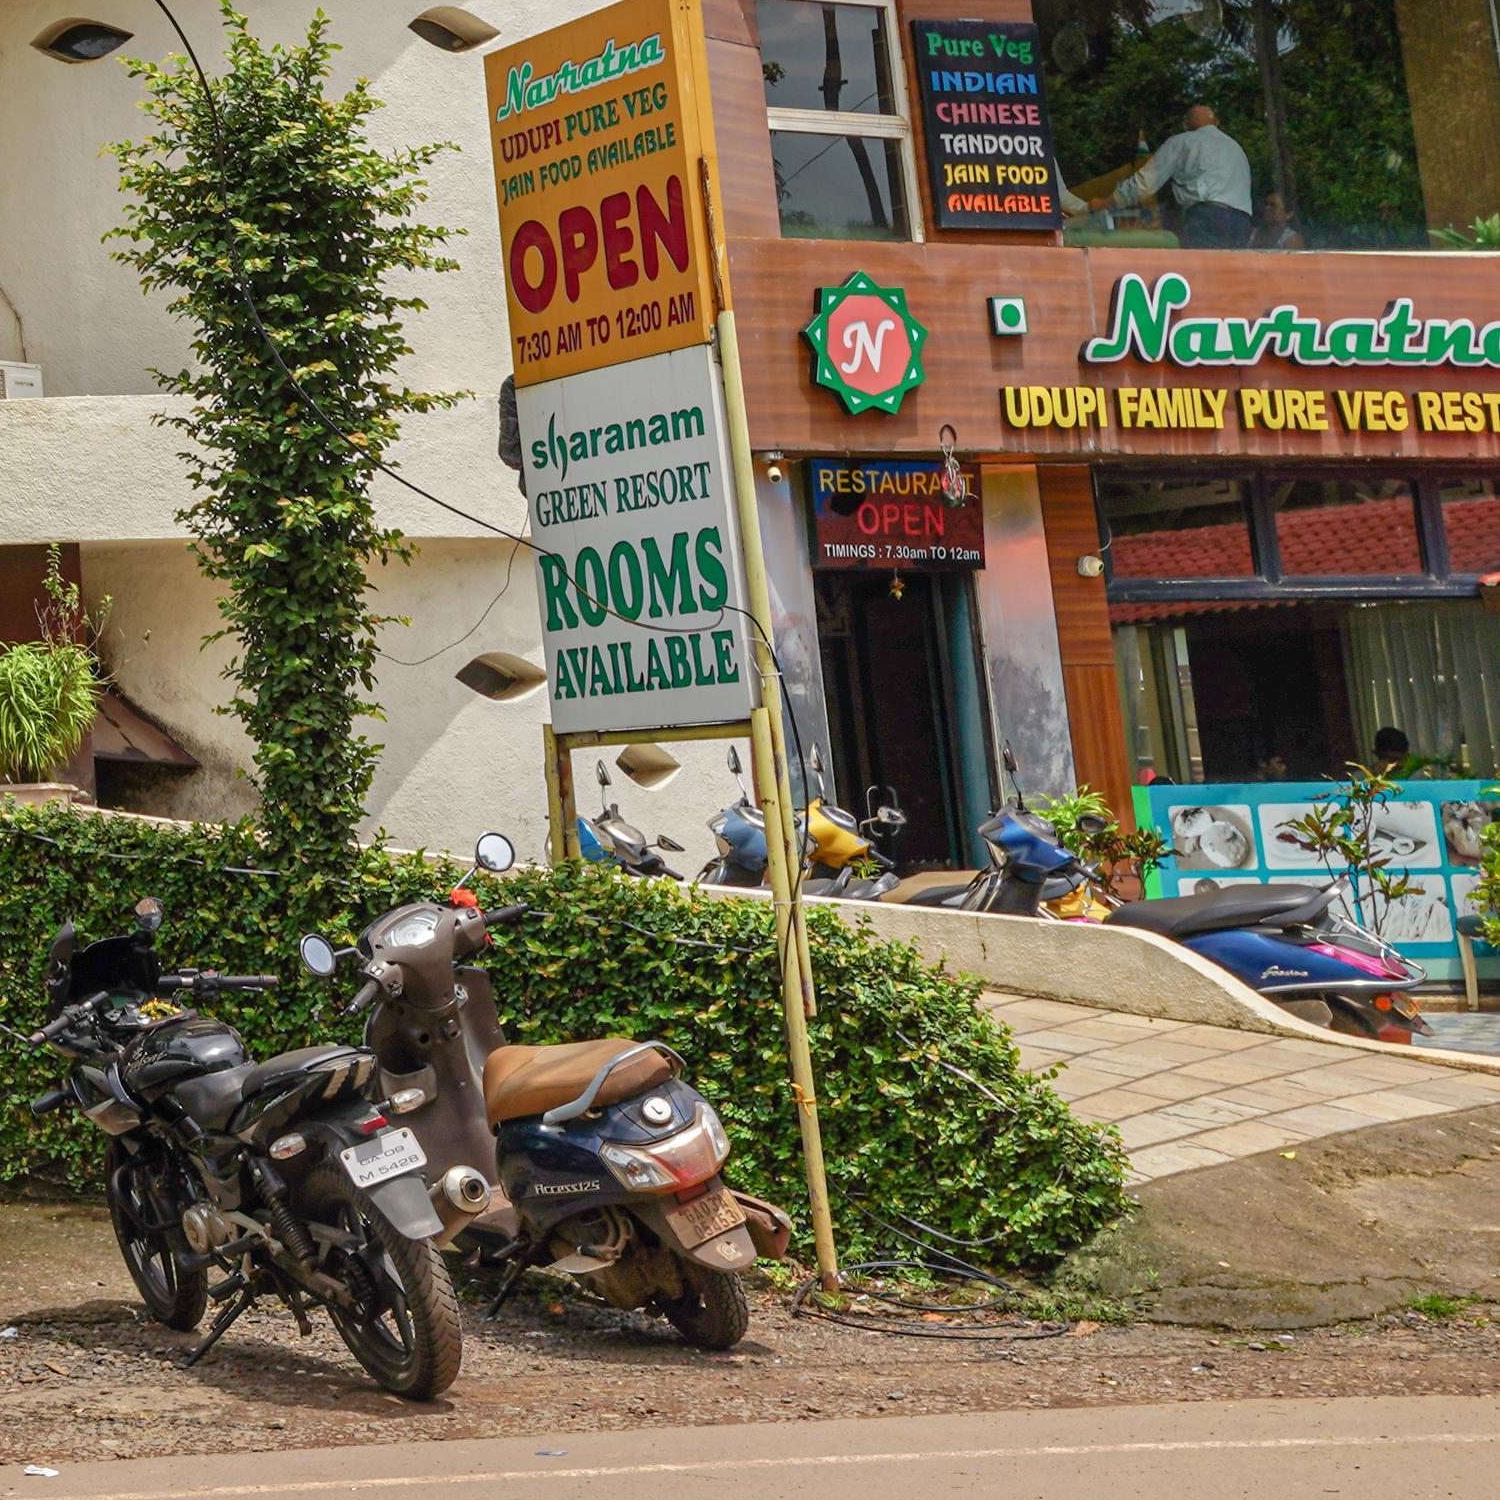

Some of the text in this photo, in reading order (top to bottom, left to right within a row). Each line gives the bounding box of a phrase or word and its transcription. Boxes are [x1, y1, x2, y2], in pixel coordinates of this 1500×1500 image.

[926, 32, 1033, 65] Pure Veg
[496, 32, 666, 123] Navratna
[931, 70, 1037, 95] INDIAN
[500, 82, 669, 164] UDUPI PURE VEG
[935, 102, 1041, 126] CHINESE
[501, 122, 677, 207] JAIN FOOD AVAILABLE
[940, 132, 1045, 158] TANDOOR
[944, 163, 1048, 187] JAIN FOOD
[947, 194, 1052, 214] AVAILABLE
[510, 174, 690, 314] OPEN
[516, 291, 696, 365] 7:30 AM TO 12:00 AM
[1005, 386, 1500, 433] UDUPI FAMILY PURE VEG REST
[535, 461, 711, 528] GREEN RESORT
[819, 468, 975, 496] RESTAURAT
[857, 502, 945, 537] OPEN
[824, 544, 876, 559] TIMINGS
[885, 546, 928, 560] 7.30am
[930, 546, 947, 560] TO
[950, 547, 980, 561] 12am
[538, 525, 729, 632] ROOMS
[554, 629, 740, 700] AVAILABLE
